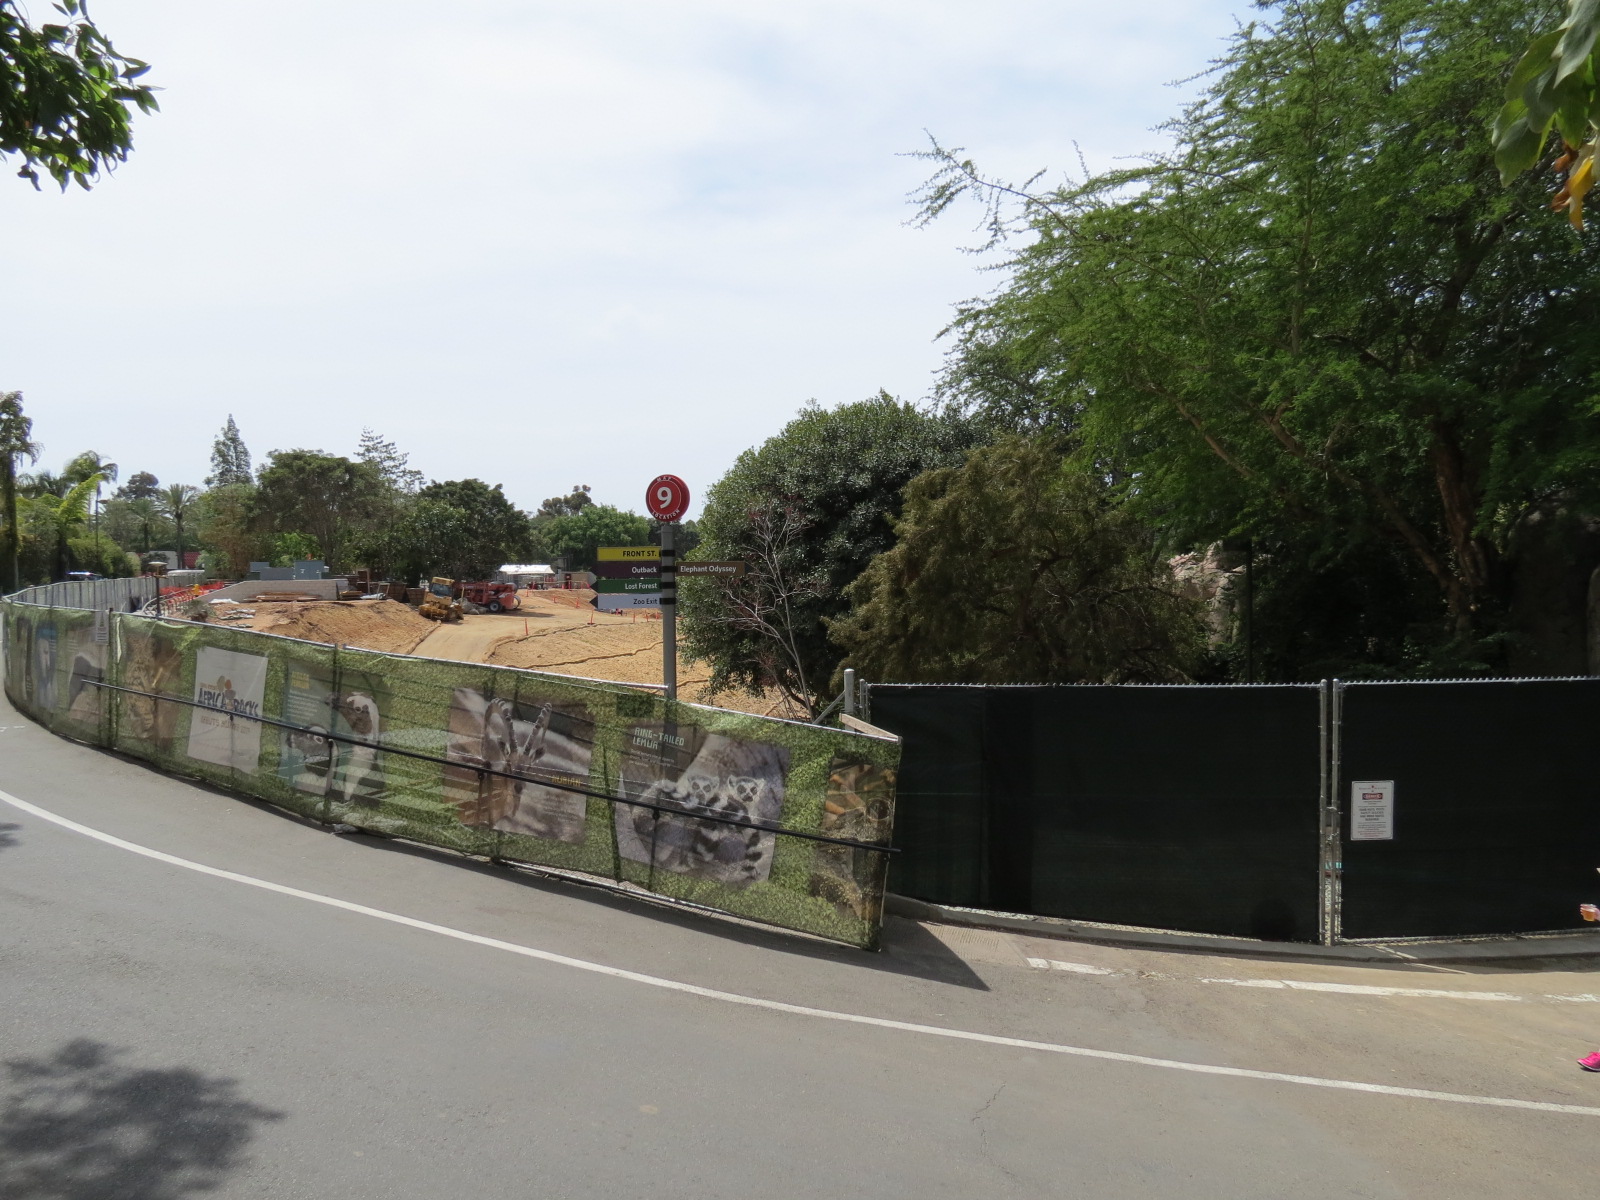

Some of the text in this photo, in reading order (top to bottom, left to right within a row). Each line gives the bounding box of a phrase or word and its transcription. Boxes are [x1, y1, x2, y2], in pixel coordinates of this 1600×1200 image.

[656, 486, 672, 509] 9
[651, 509, 681, 520] LOCATION
[680, 565, 737, 574] Elephant Odyssey
[646, 597, 658, 605] Exit
[634, 727, 685, 746] RING-TAILED
[632, 736, 659, 750] LEMUR
